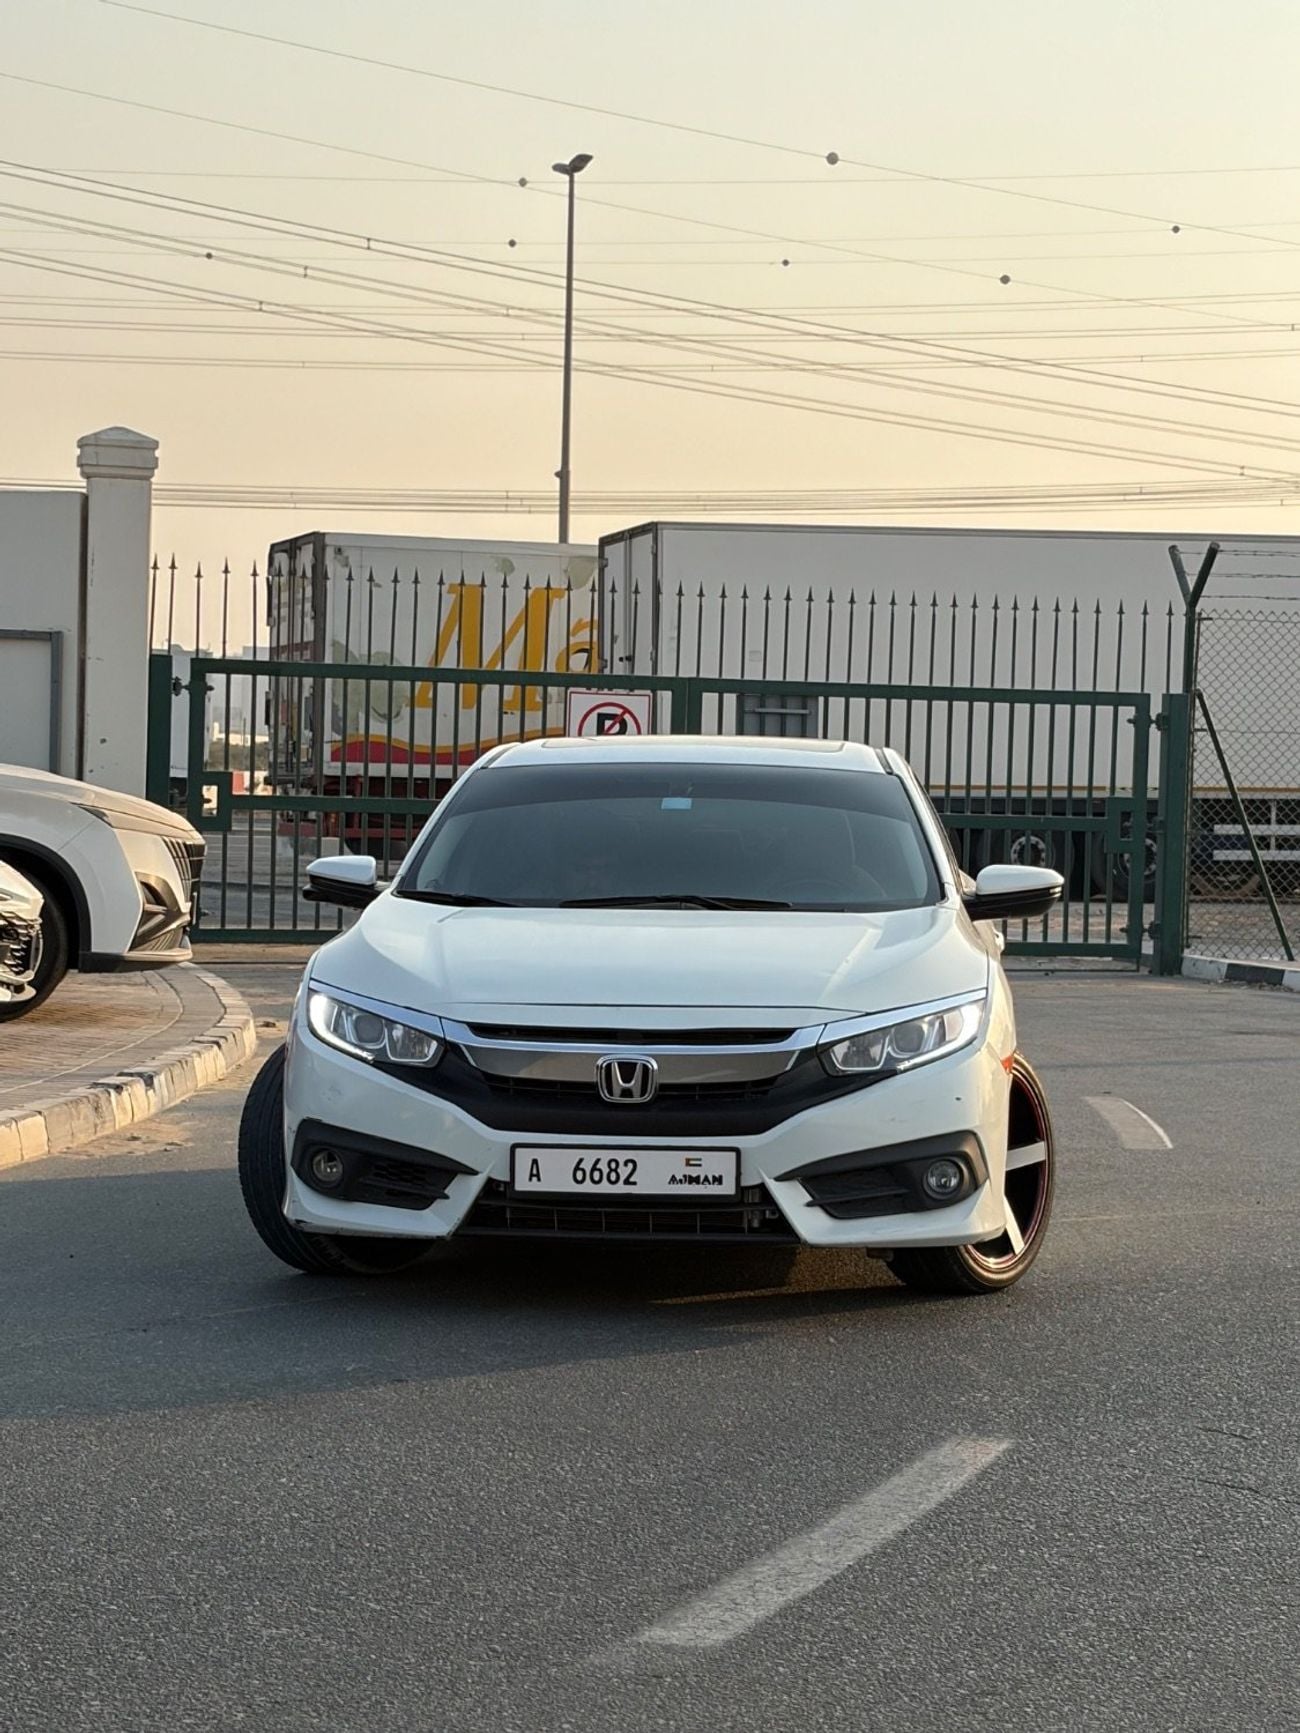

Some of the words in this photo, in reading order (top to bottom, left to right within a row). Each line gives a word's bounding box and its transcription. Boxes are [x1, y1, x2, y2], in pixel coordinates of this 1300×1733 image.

[528, 1158, 542, 1183] A
[572, 1157, 638, 1186] 6682
[668, 1174, 723, 1186] AJMAN
